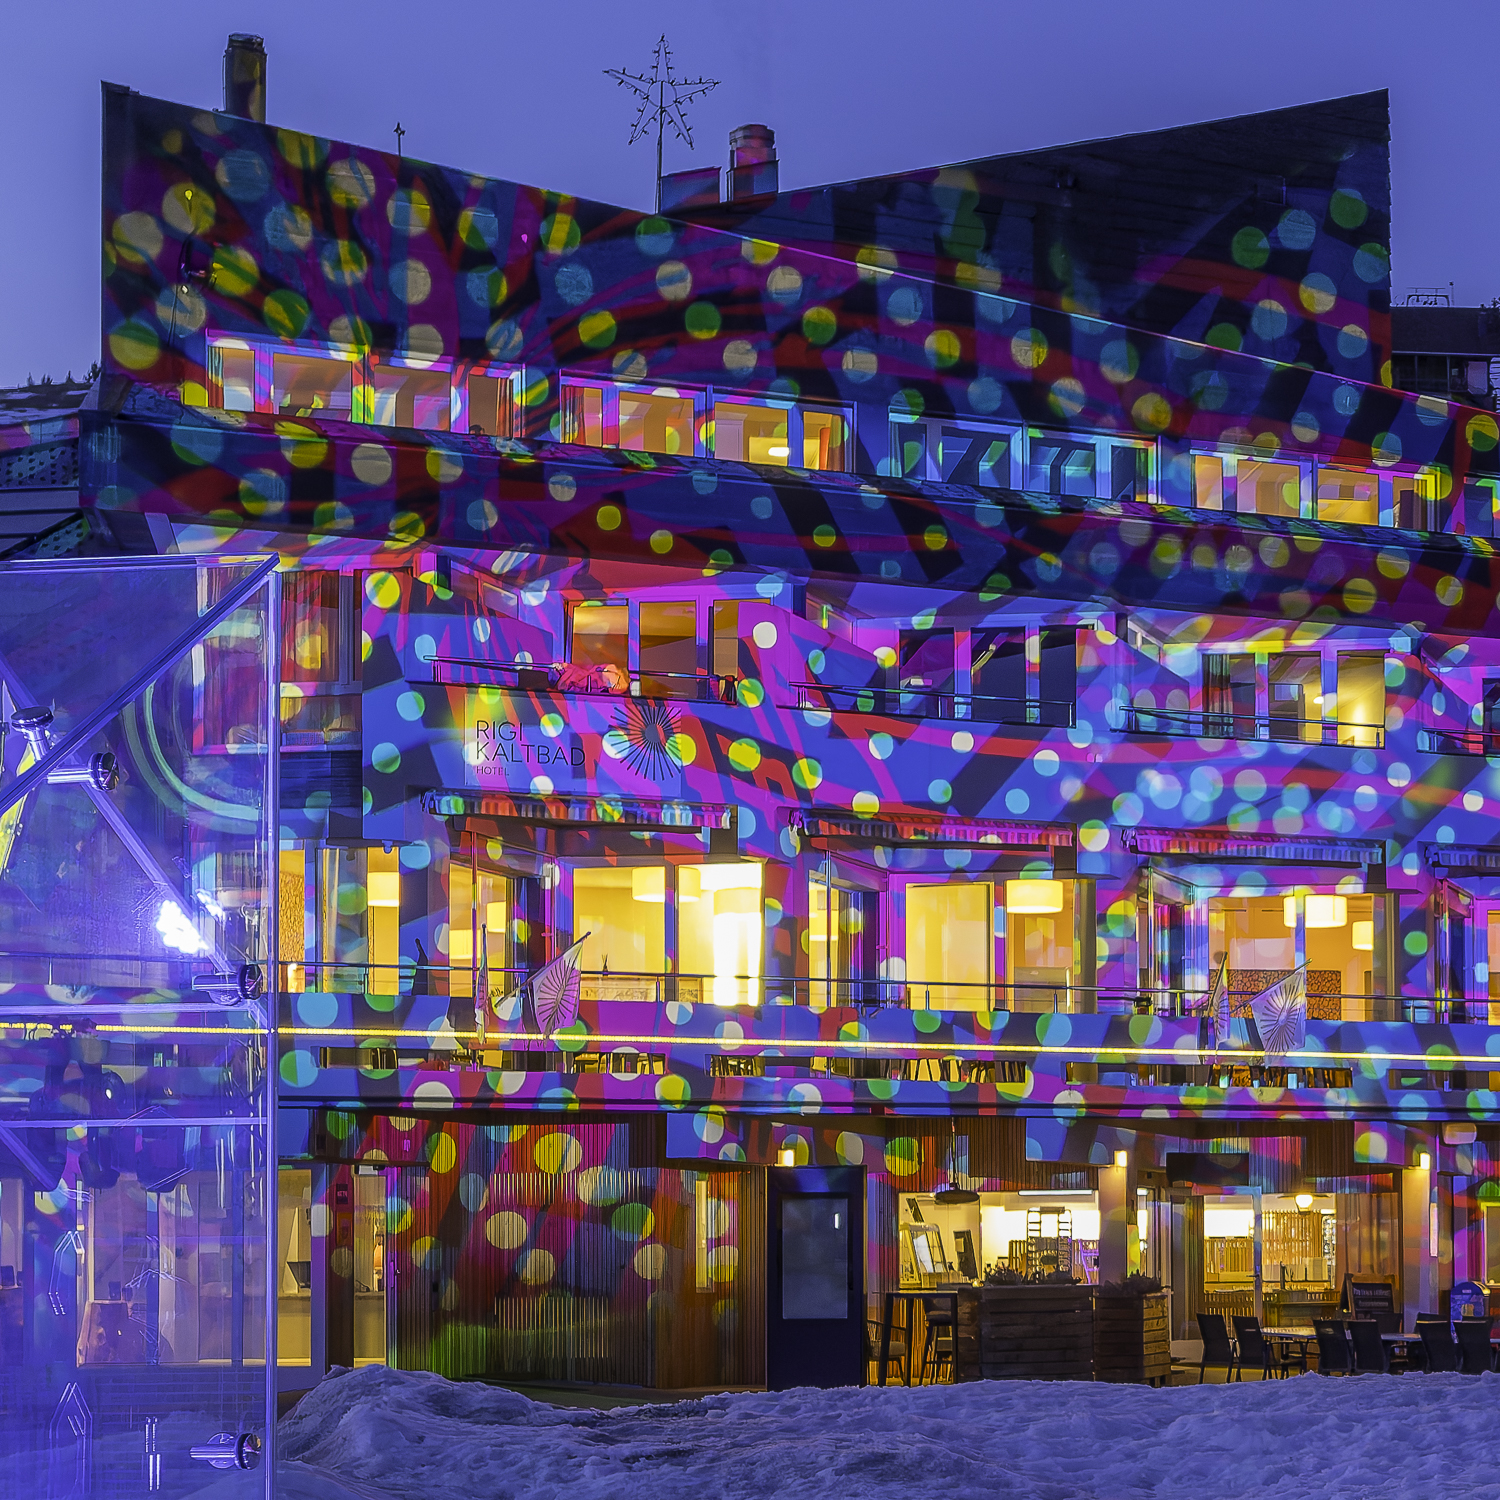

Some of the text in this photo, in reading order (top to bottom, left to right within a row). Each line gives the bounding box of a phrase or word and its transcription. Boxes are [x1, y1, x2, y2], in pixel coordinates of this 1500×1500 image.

[476, 720, 523, 741] RIGI
[476, 741, 586, 766] KALTBAD
[476, 765, 510, 776] HOTEL
